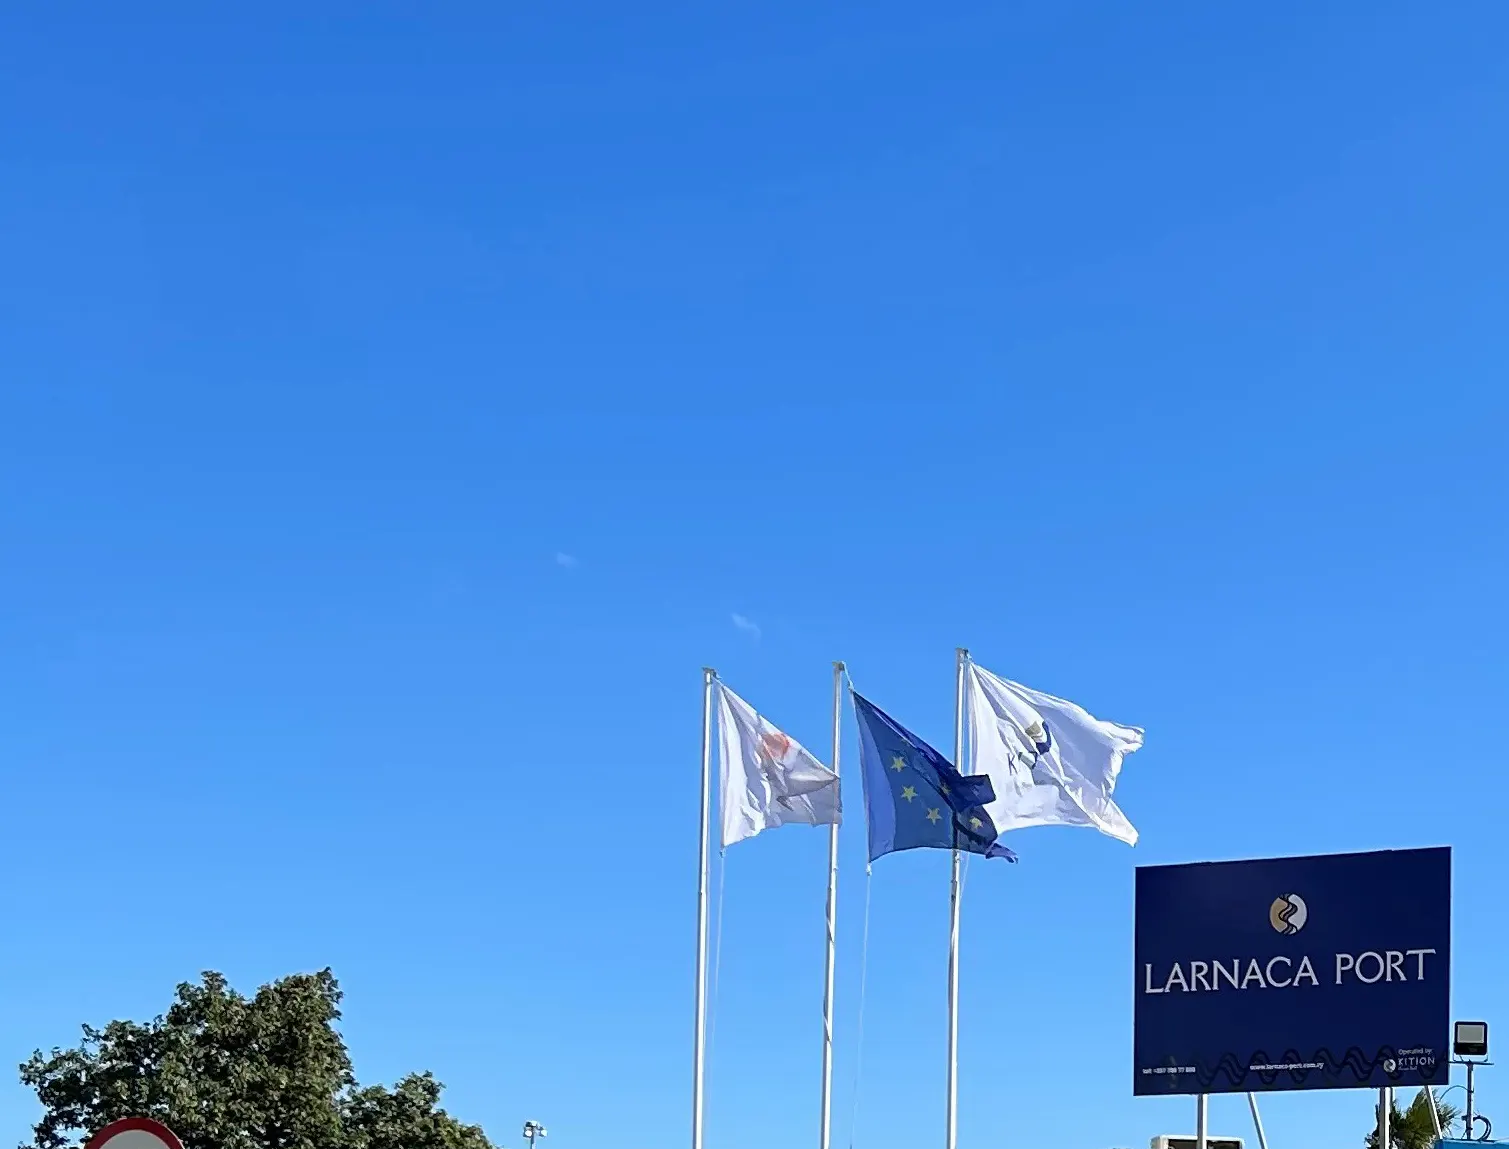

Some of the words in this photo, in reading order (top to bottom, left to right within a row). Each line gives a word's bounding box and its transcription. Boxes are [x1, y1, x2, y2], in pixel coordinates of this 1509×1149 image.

[1145, 956, 1319, 993] LARNACA
[1335, 949, 1436, 985] PORT
[1397, 1057, 1435, 1066] KITION
